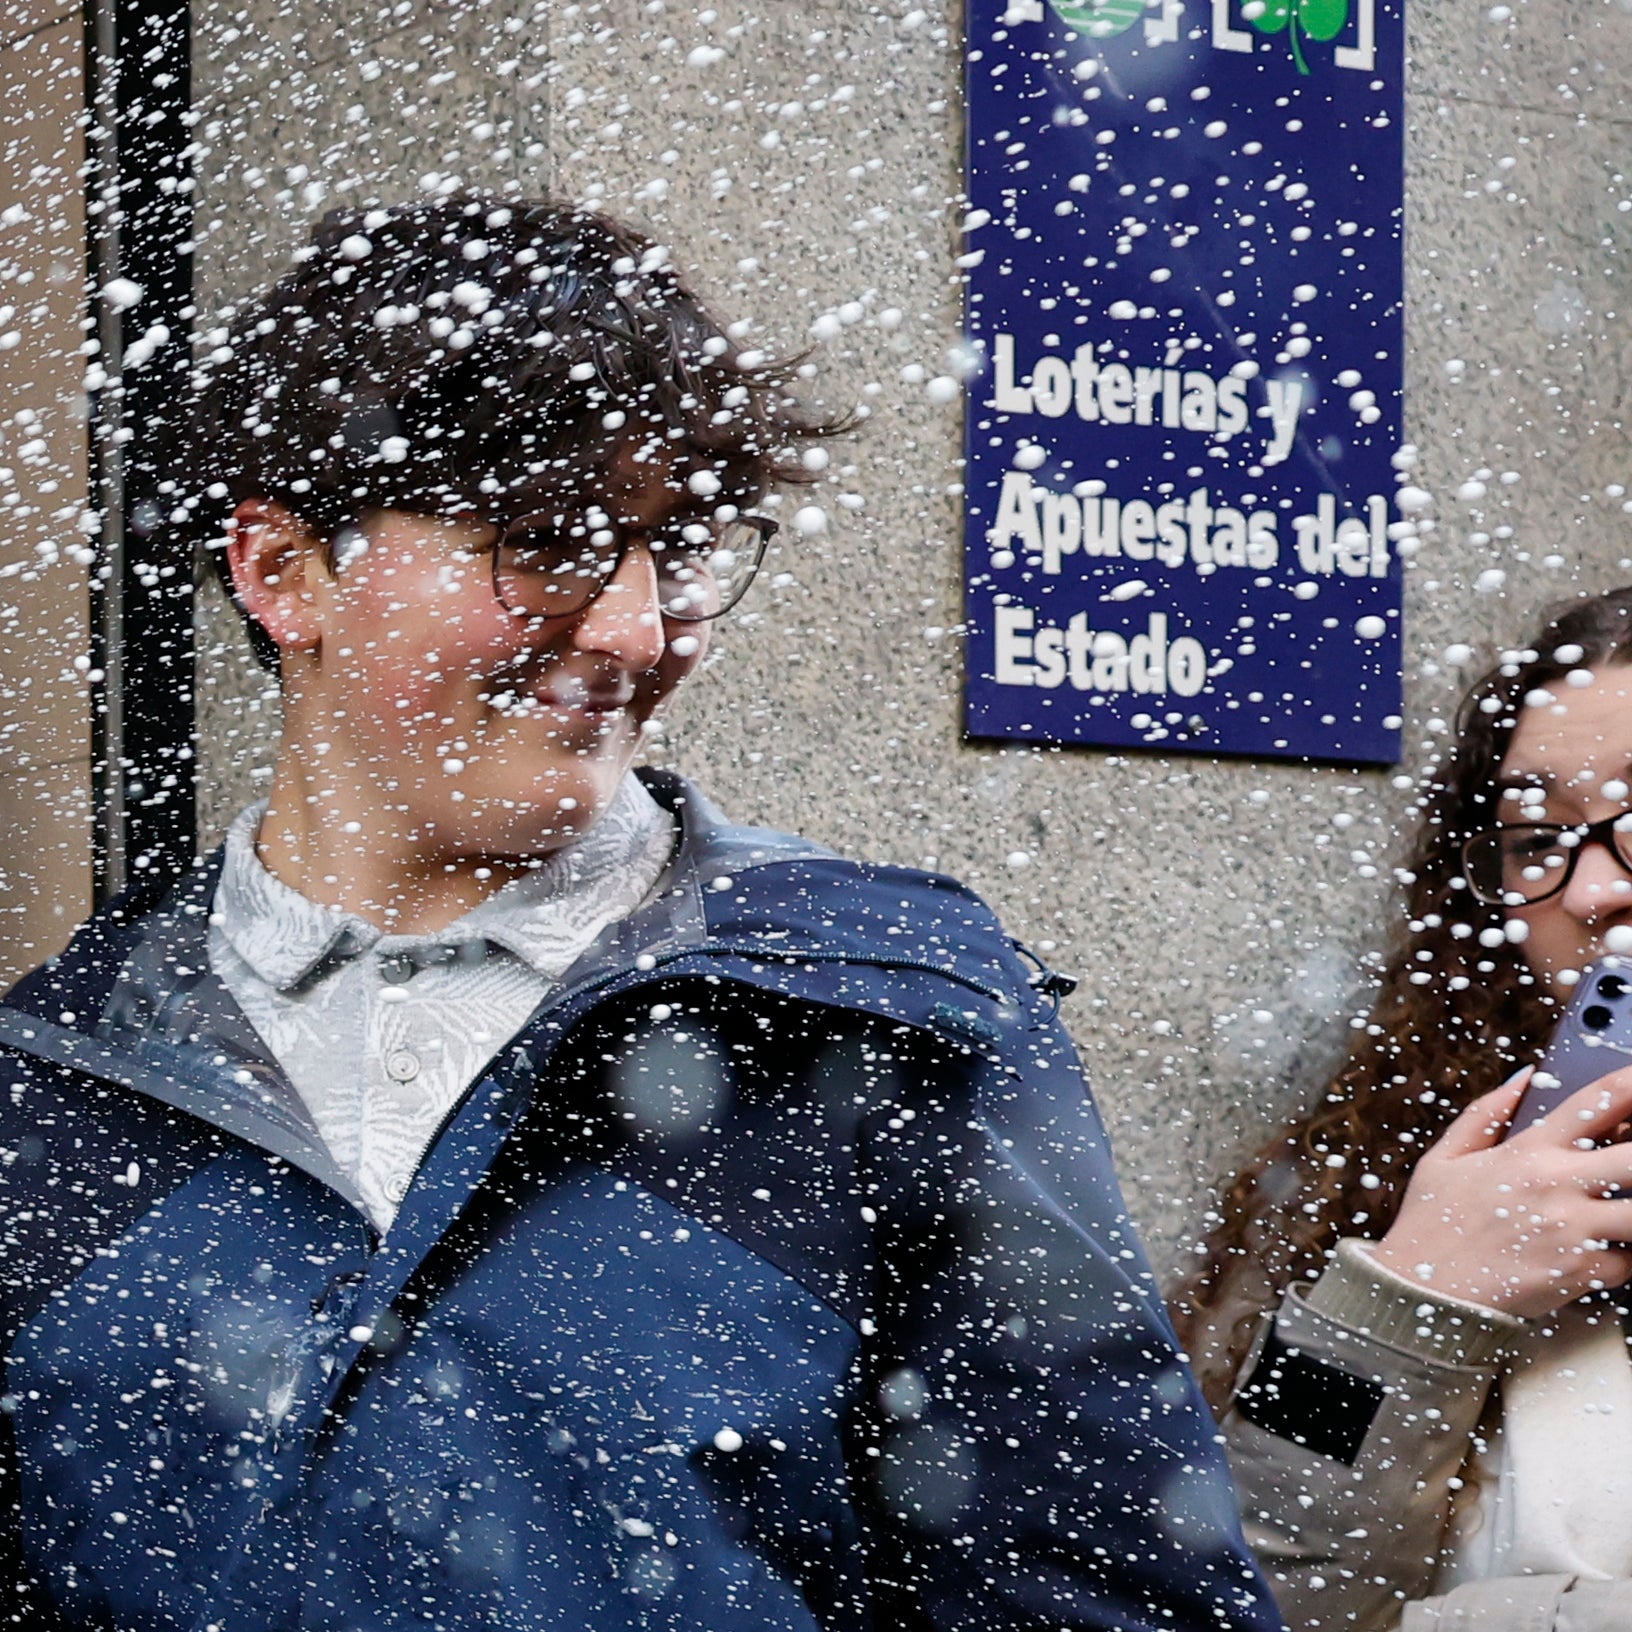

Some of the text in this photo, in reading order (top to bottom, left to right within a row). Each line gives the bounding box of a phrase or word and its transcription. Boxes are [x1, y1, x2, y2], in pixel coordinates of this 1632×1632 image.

[994, 332, 1304, 462] Loterías y
[991, 470, 1390, 579] Apuestas del
[994, 605, 1207, 697] Estado
